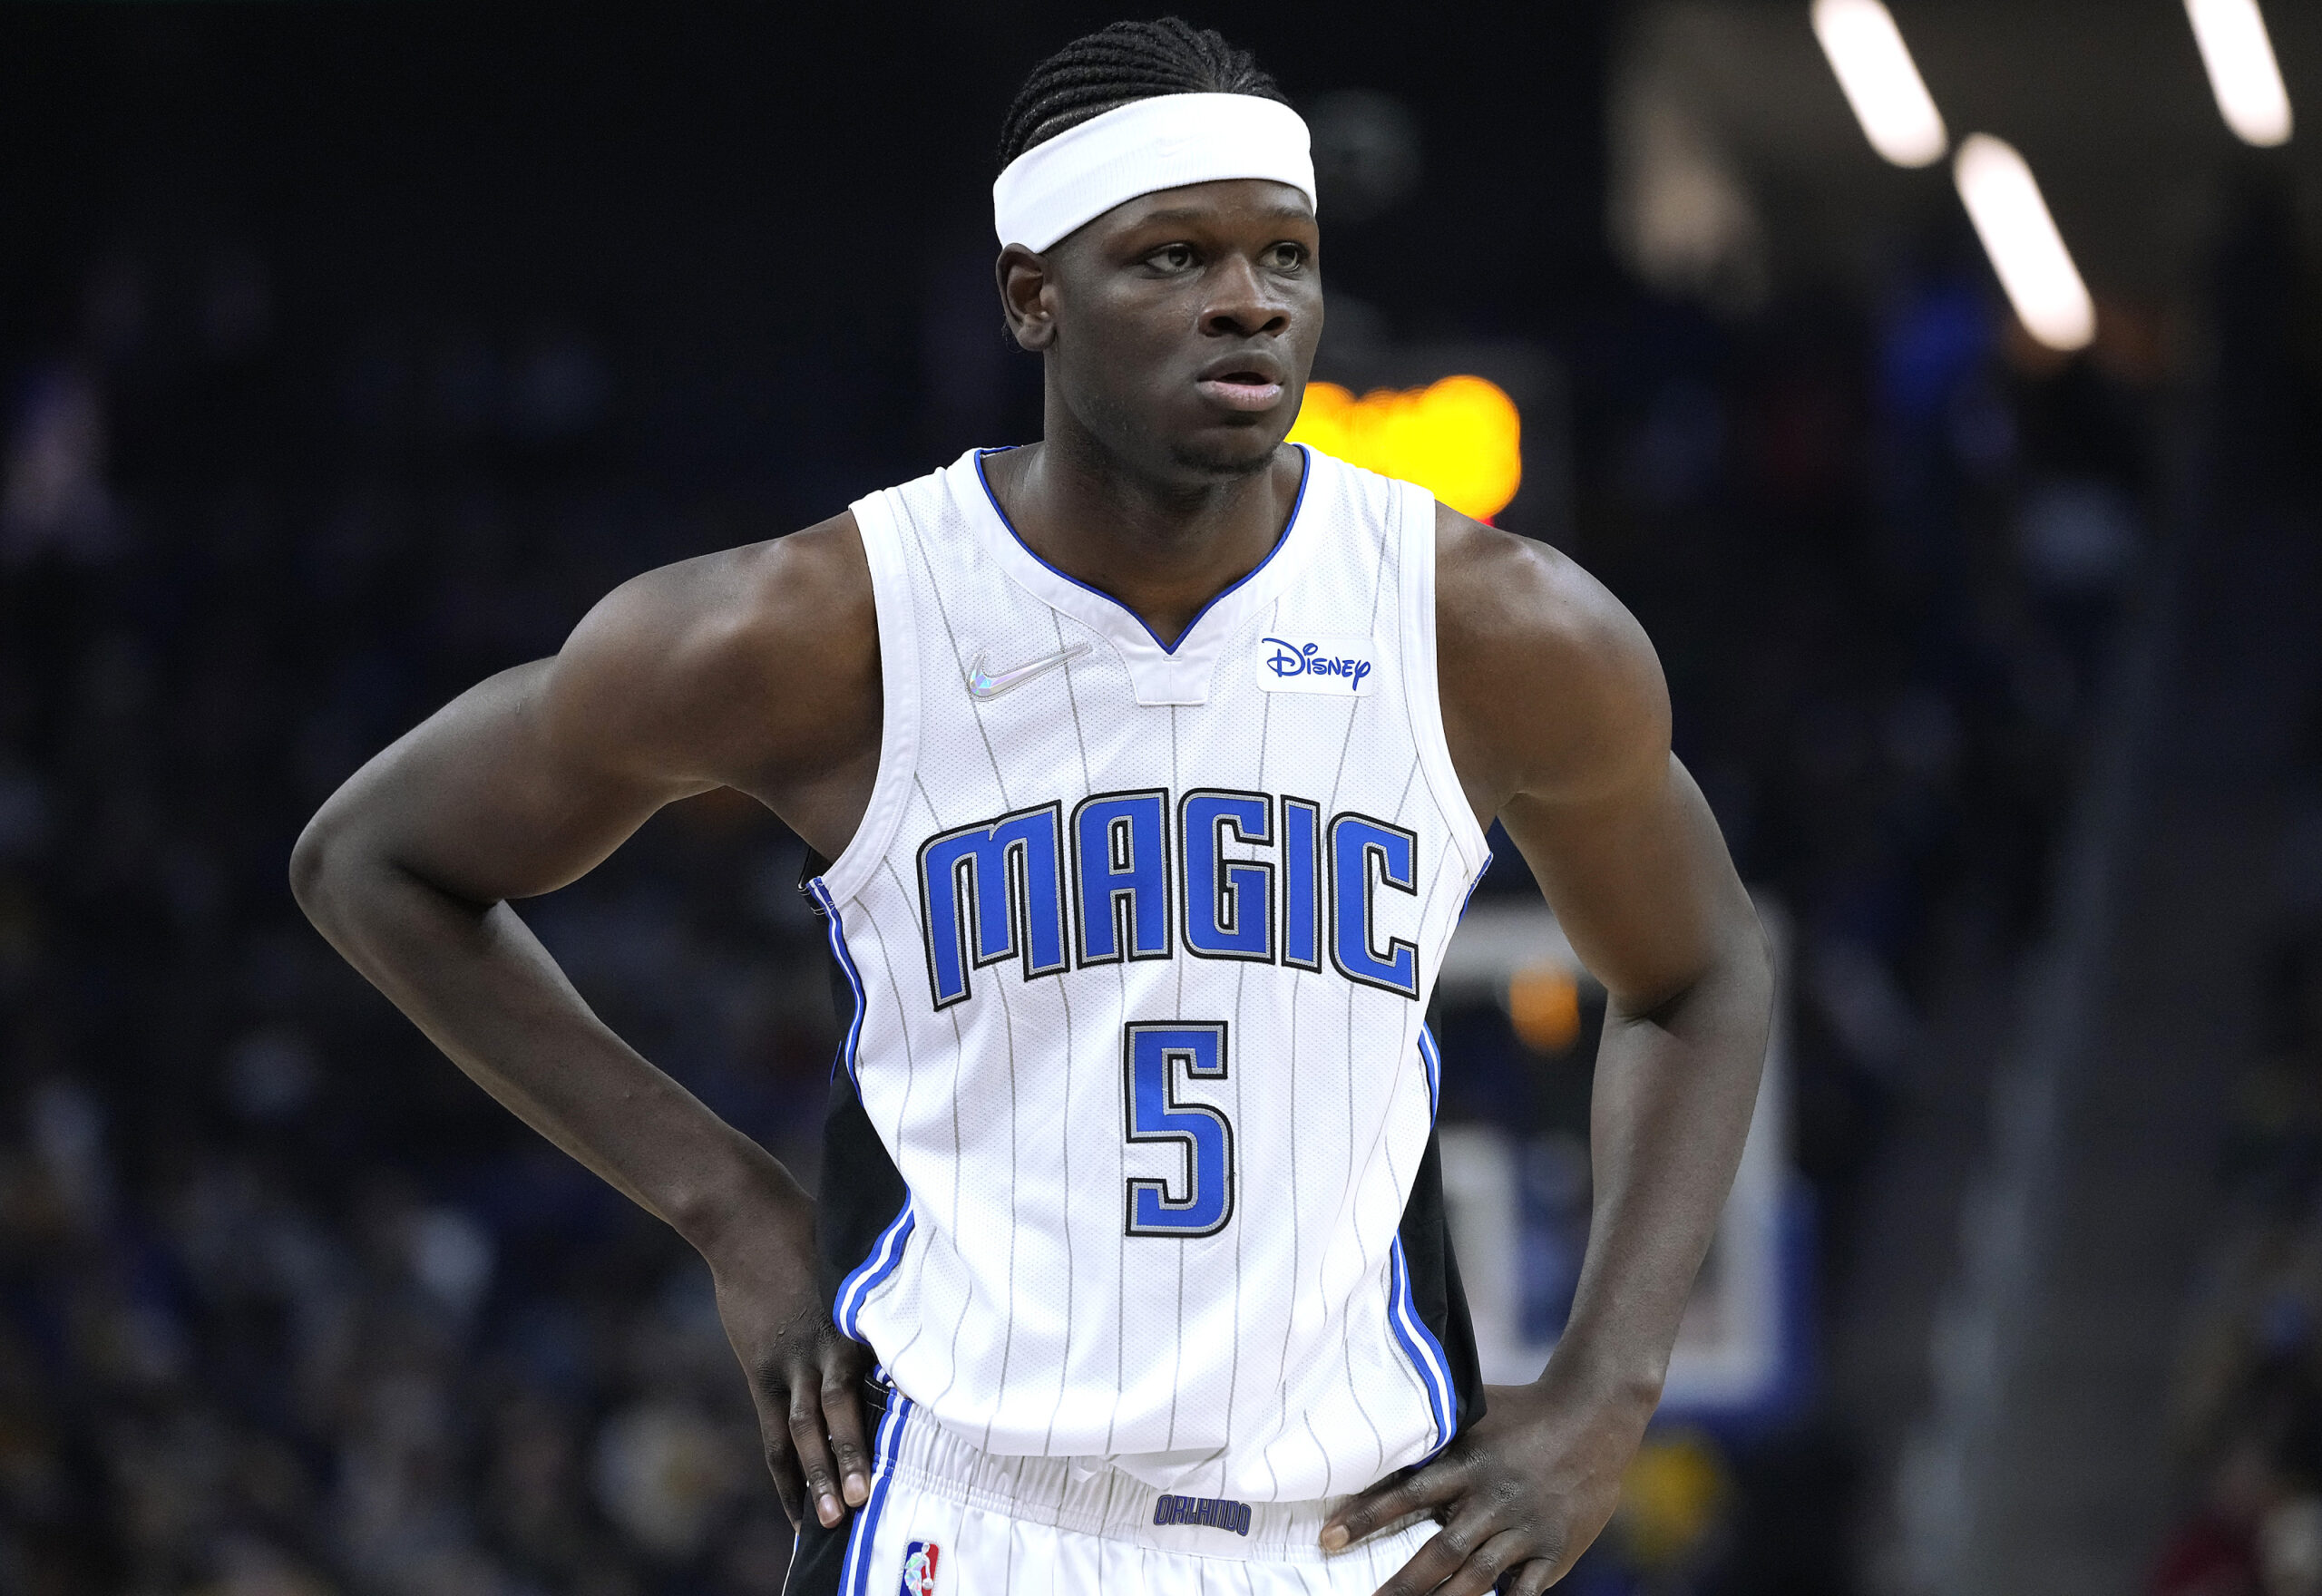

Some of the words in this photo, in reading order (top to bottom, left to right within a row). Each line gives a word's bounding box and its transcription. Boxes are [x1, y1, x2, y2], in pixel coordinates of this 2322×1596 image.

[1262, 637, 1371, 691] Disney
[917, 787, 1420, 1012] MAGIC
[1125, 1020, 1234, 1238] 5
[1154, 1494, 1252, 1536] ORLANDO
